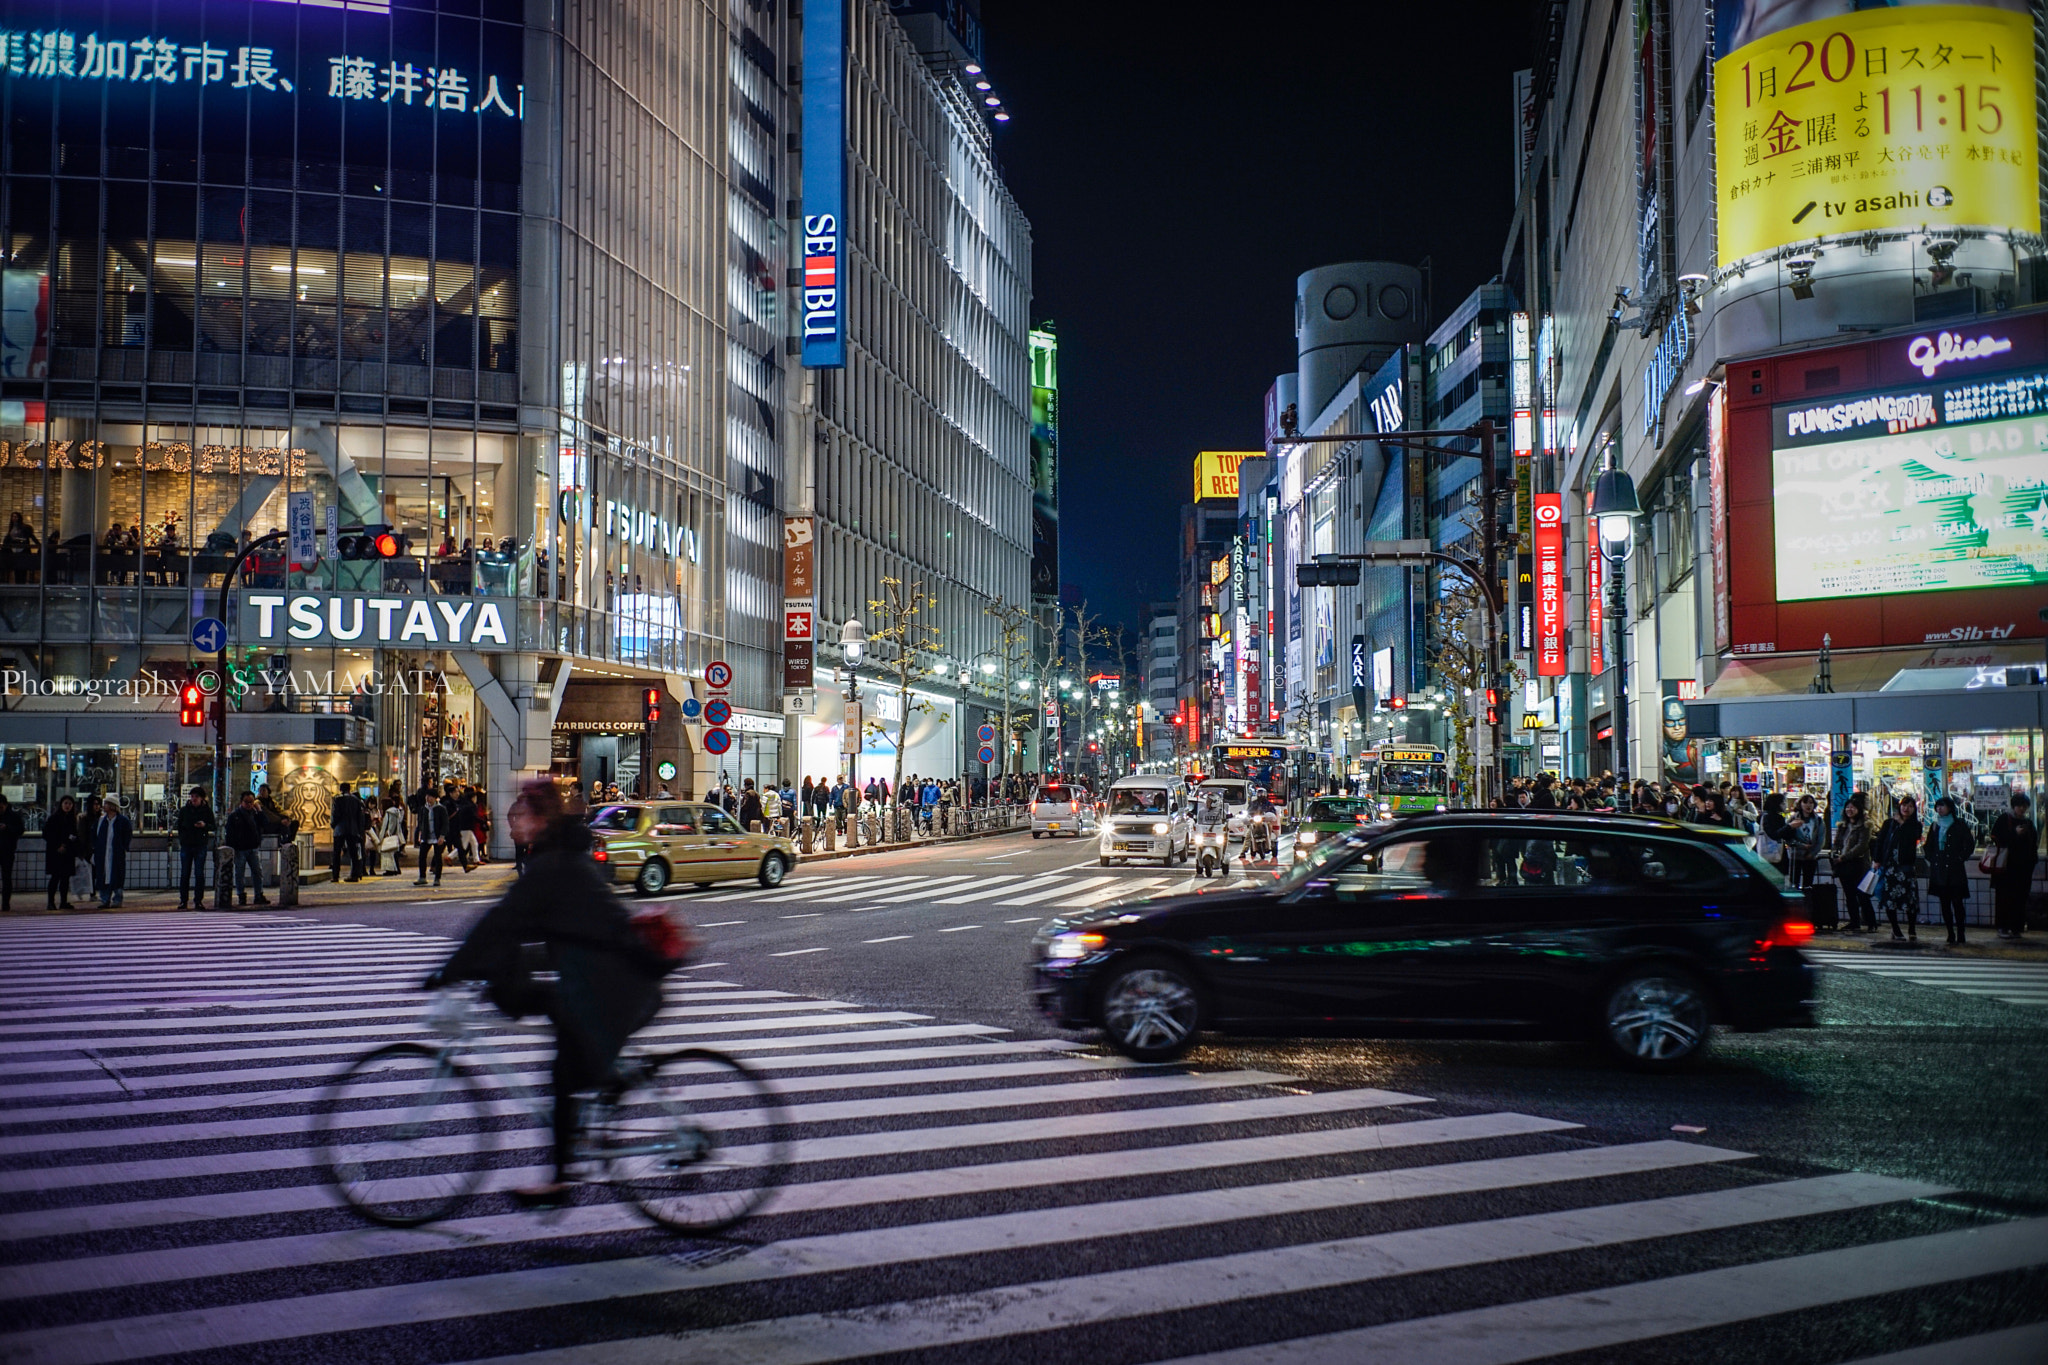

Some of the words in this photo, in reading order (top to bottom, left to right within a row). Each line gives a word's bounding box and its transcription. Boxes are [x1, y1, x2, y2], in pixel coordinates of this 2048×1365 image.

[1875, 83, 2004, 136] 11:15
[1790, 150, 1861, 180] 三浦翔平
[1823, 201, 1847, 218] tv
[1854, 190, 1920, 213] asahi
[804, 213, 836, 339] SEIBU
[135, 441, 306, 477] COFFEE
[299, 497, 313, 557] 渋谷駅前
[1233, 536, 1245, 601] KARAOKE
[249, 595, 508, 645] TSUTAYA
[789, 615, 808, 635] 本
[1541, 546, 1559, 664] 三菱東京UFJ銀行
[1352, 643, 1365, 687] ZARA
[1733, 642, 1776, 653] 三千里薬品
